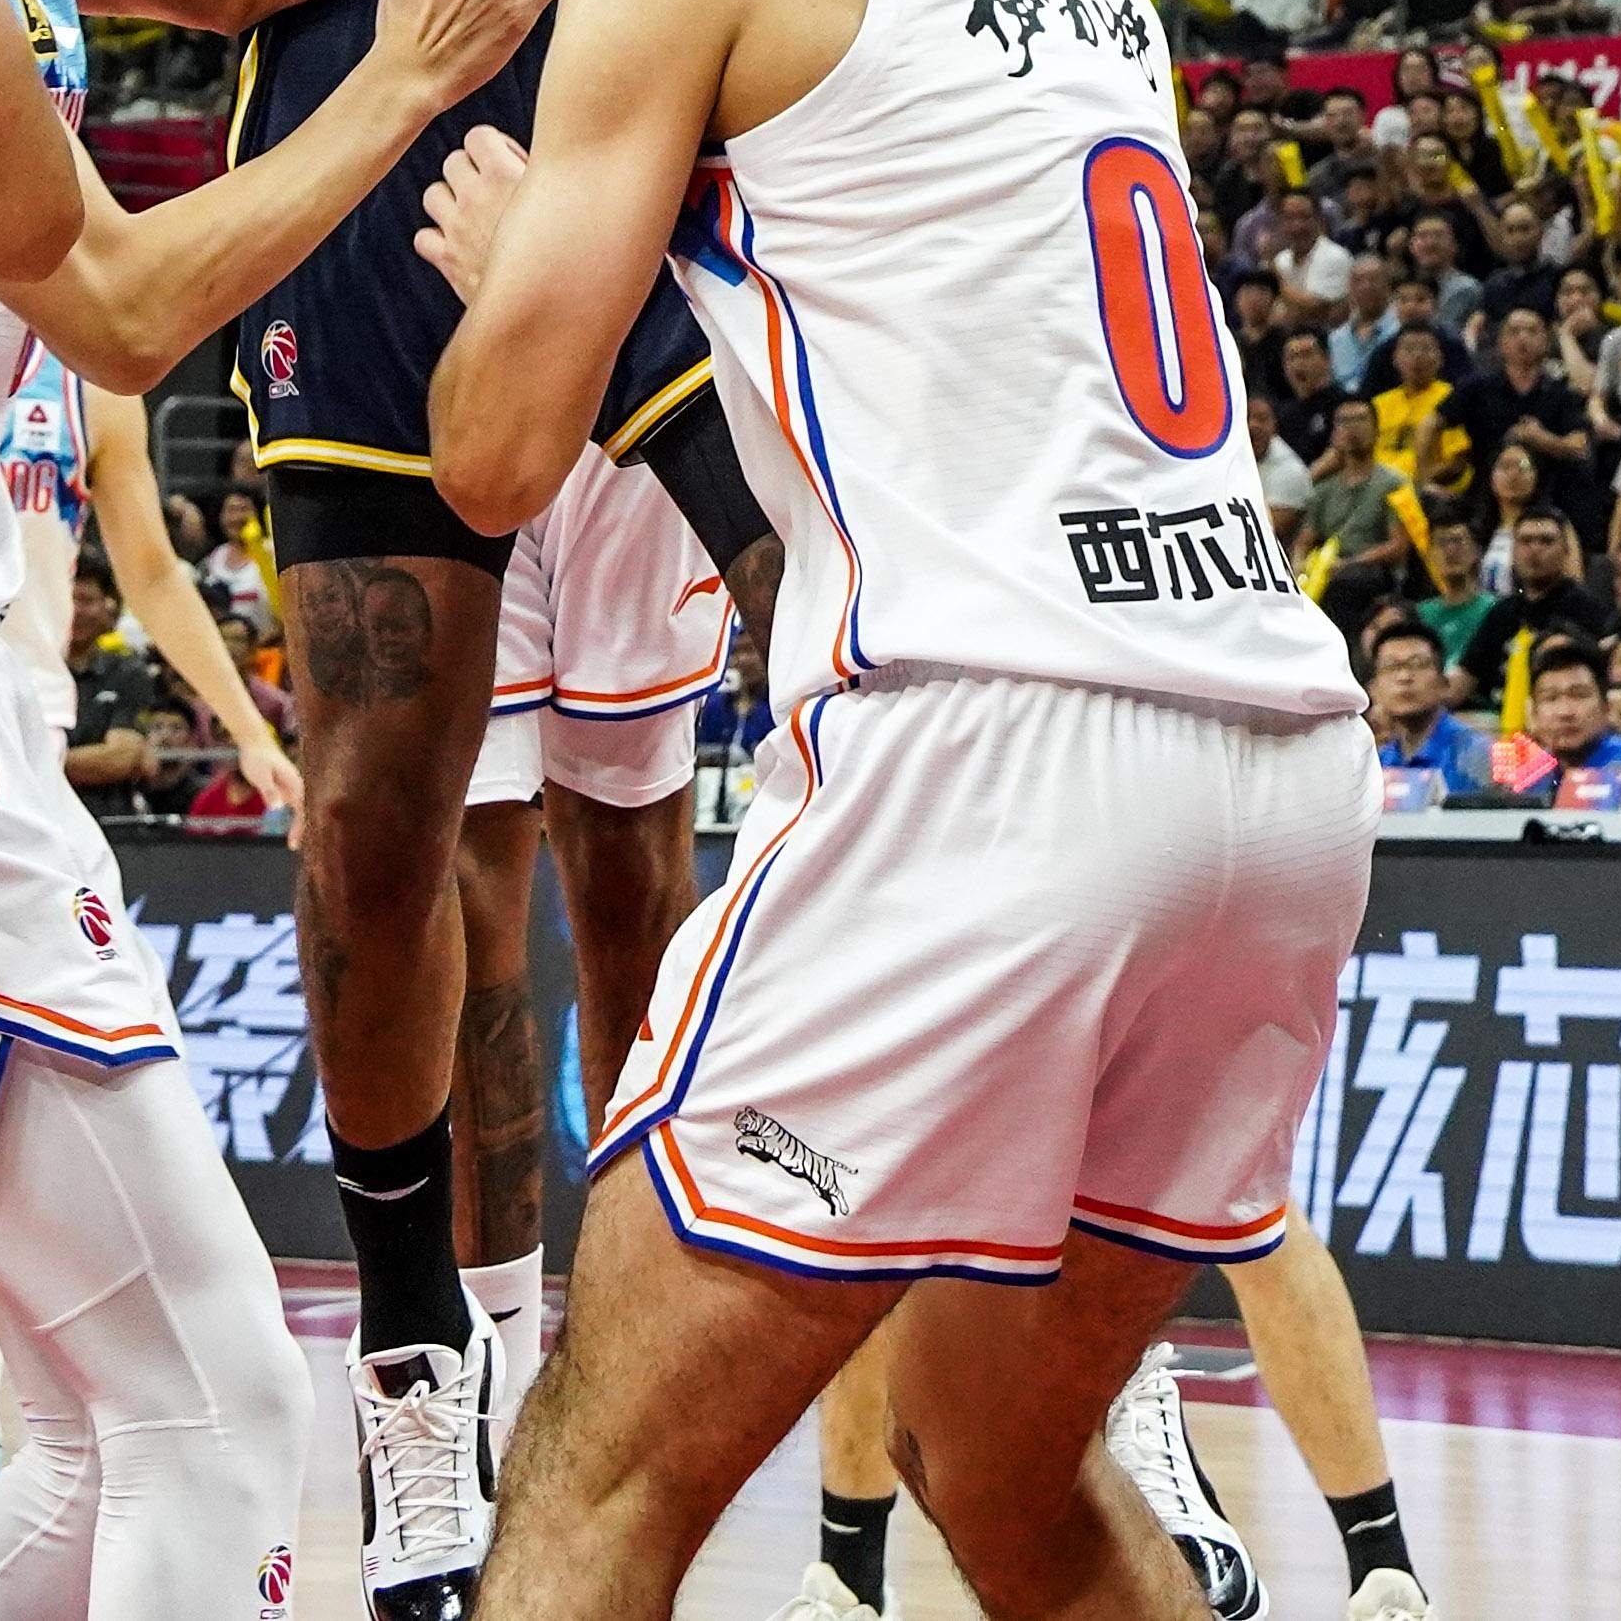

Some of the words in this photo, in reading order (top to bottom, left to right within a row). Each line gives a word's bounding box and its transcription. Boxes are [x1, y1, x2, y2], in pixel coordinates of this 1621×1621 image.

[1083, 137, 1232, 460] 0
[268, 380, 300, 399] CBA
[1059, 498, 1301, 603] 西尔扎
